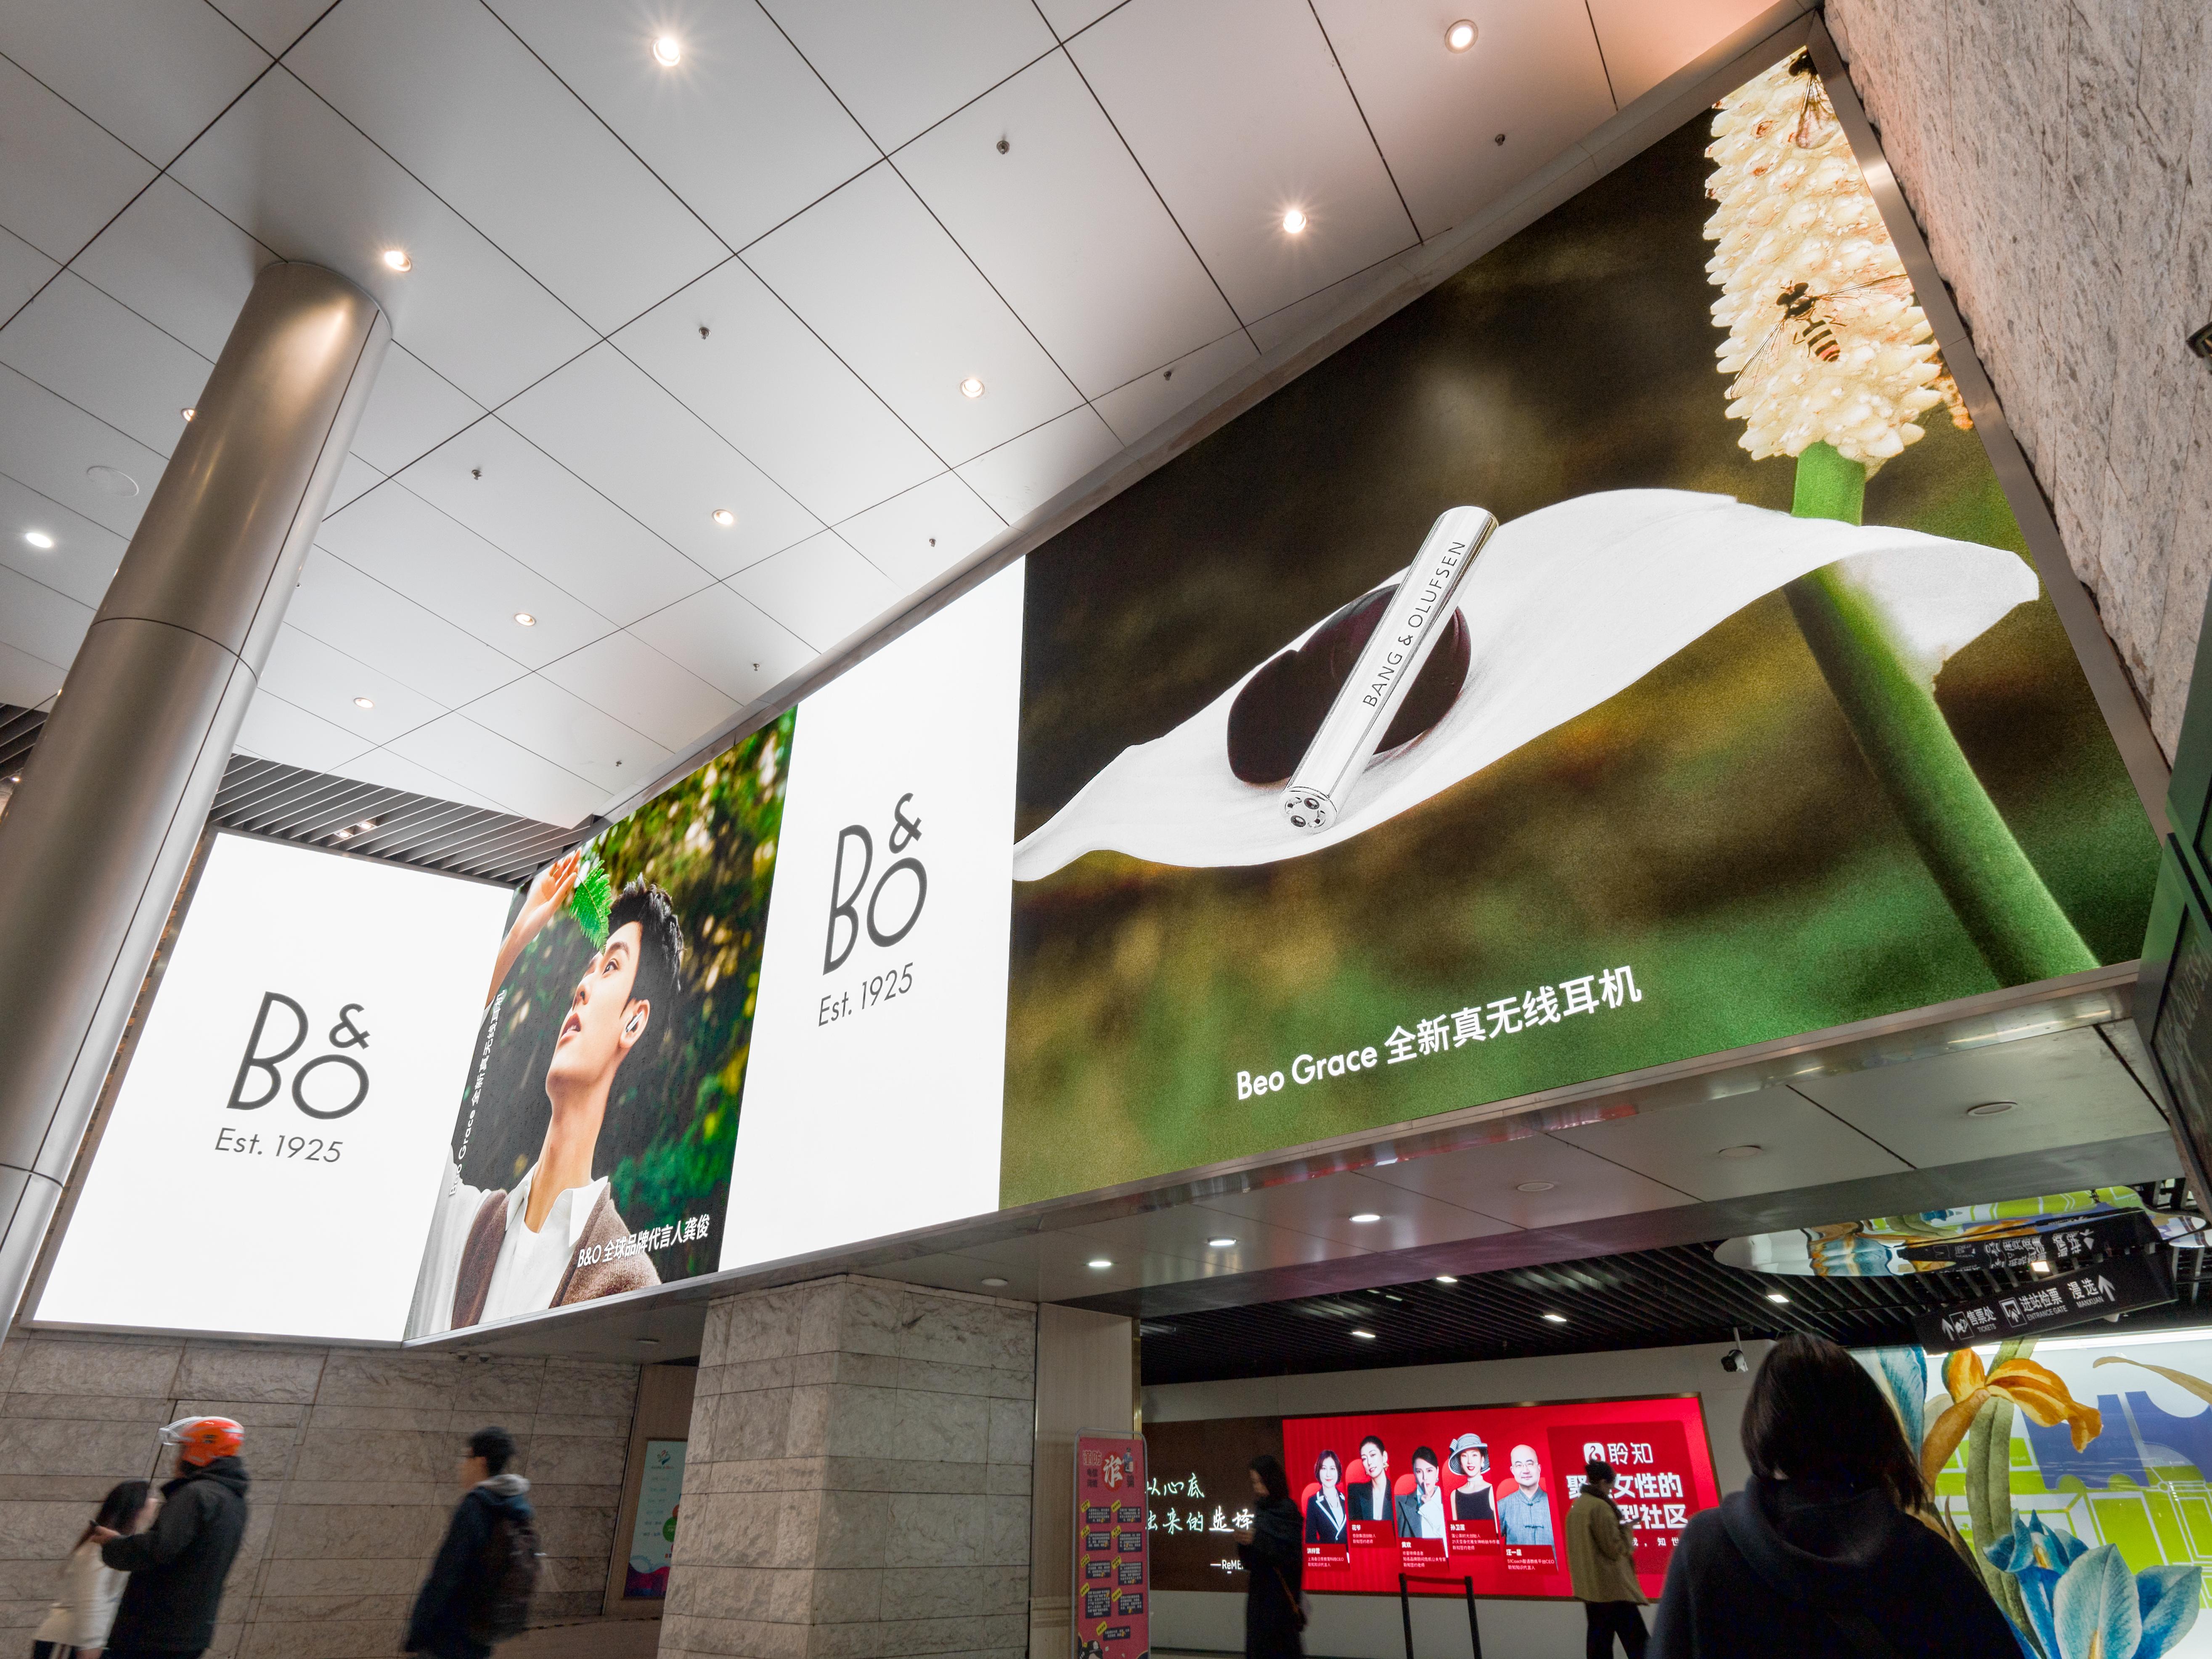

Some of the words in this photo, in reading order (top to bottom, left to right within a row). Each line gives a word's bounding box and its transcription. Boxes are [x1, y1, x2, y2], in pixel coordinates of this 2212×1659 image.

[1362, 651, 1403, 707] BANG
[1398, 634, 1412, 646] &
[1407, 541, 1466, 628] OLUFSEN
[819, 991, 852, 1027] Est.
[861, 962, 913, 1010] 1925
[1237, 1070, 1284, 1100] Beo
[1291, 1046, 1378, 1085] Grace
[1384, 965, 1642, 1065] 全新真无线耳机
[449, 1163, 463, 1195] Beo
[458, 1110, 475, 1160] Grace
[472, 989, 505, 1106] 全新真无线耳机
[215, 1127, 262, 1155] Est.
[276, 1135, 343, 1162] 1925
[577, 1244, 602, 1268] B&O
[602, 1214, 710, 1263] 全球品牌代言人龚俊
[2019, 1288, 2063, 1312] 进站检票
[2026, 1308, 2053, 1322] ENTRANCE
[2053, 1305, 2068, 1314] GATE
[2076, 1296, 2103, 1309] MANXUAN
[1966, 1306, 1997, 1326] 售票处
[1977, 1324, 1997, 1333] TICKETS
[1607, 1442, 1653, 1465] 聆知
[1566, 1472, 1683, 1499] 聚女性的
